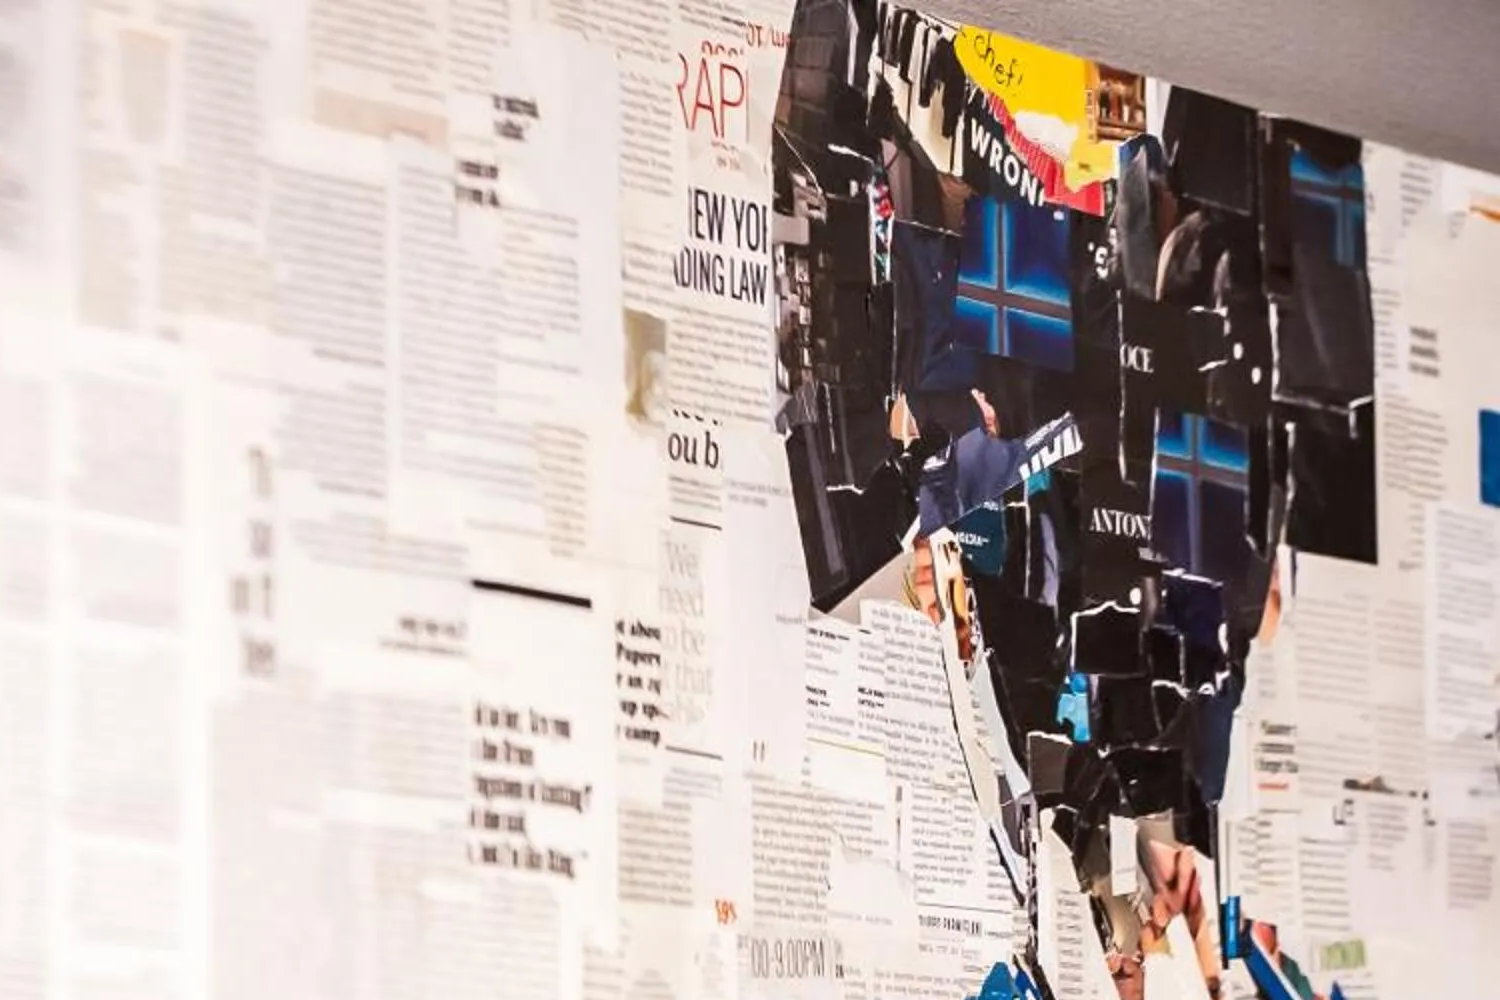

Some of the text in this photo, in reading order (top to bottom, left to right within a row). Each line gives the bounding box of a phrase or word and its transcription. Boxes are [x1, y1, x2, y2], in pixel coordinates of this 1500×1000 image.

[971, 118, 1045, 207] WRON
[688, 186, 726, 246] EW
[731, 262, 767, 305] LAW
